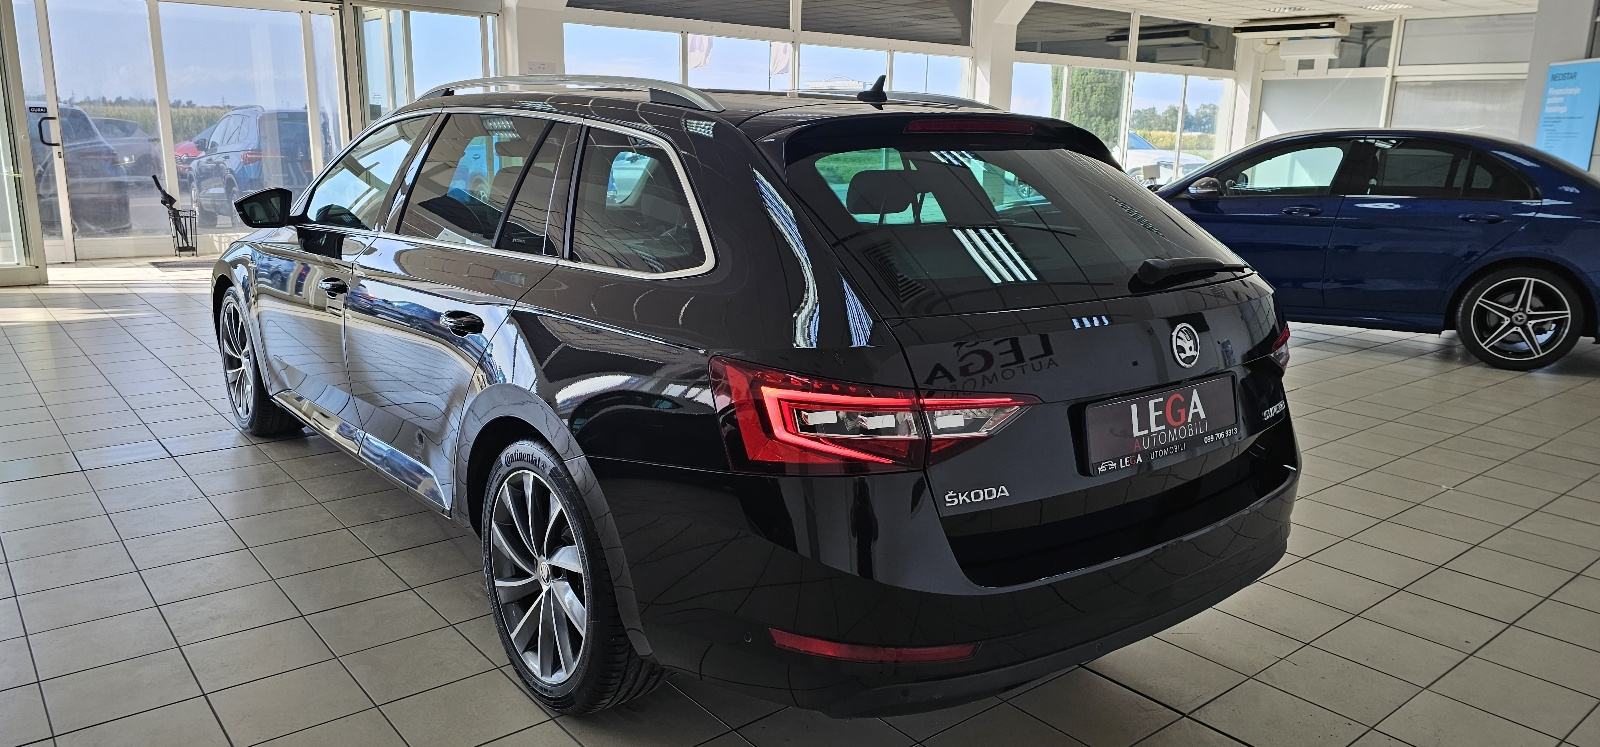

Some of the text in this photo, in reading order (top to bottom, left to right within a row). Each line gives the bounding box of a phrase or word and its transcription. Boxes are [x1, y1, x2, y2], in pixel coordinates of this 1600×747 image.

[1130, 388, 1207, 438] LEGA
[1134, 420, 1208, 451] AUTOMOBILI
[505, 449, 540, 468] Continental
[1119, 453, 1143, 469] LEGA
[945, 485, 1010, 506] ŠKODA
